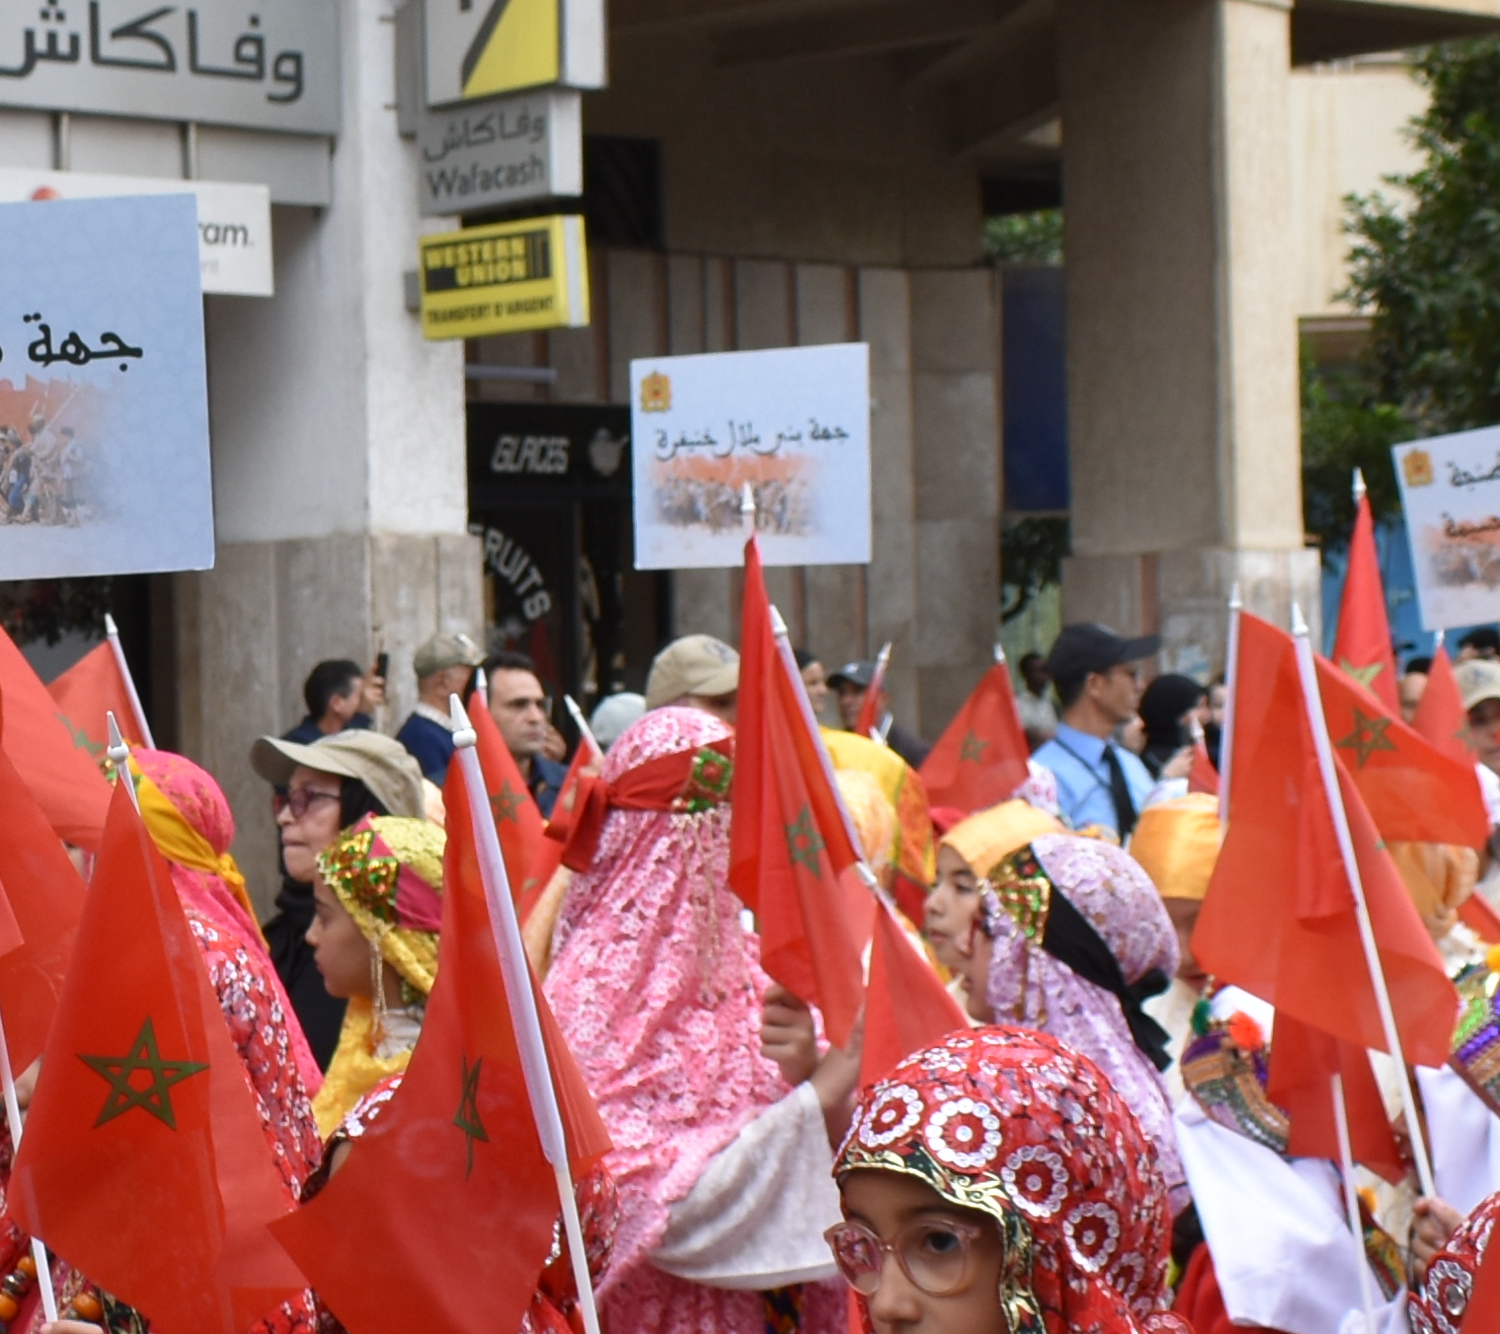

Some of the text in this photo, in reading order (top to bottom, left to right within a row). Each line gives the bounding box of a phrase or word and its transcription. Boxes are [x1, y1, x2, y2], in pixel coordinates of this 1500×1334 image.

[427, 154, 545, 199] Wafacash
[426, 235, 526, 268] WESTERN
[456, 259, 527, 287] UNION
[22, 312, 144, 373] جهة
[808, 417, 849, 445] جهة
